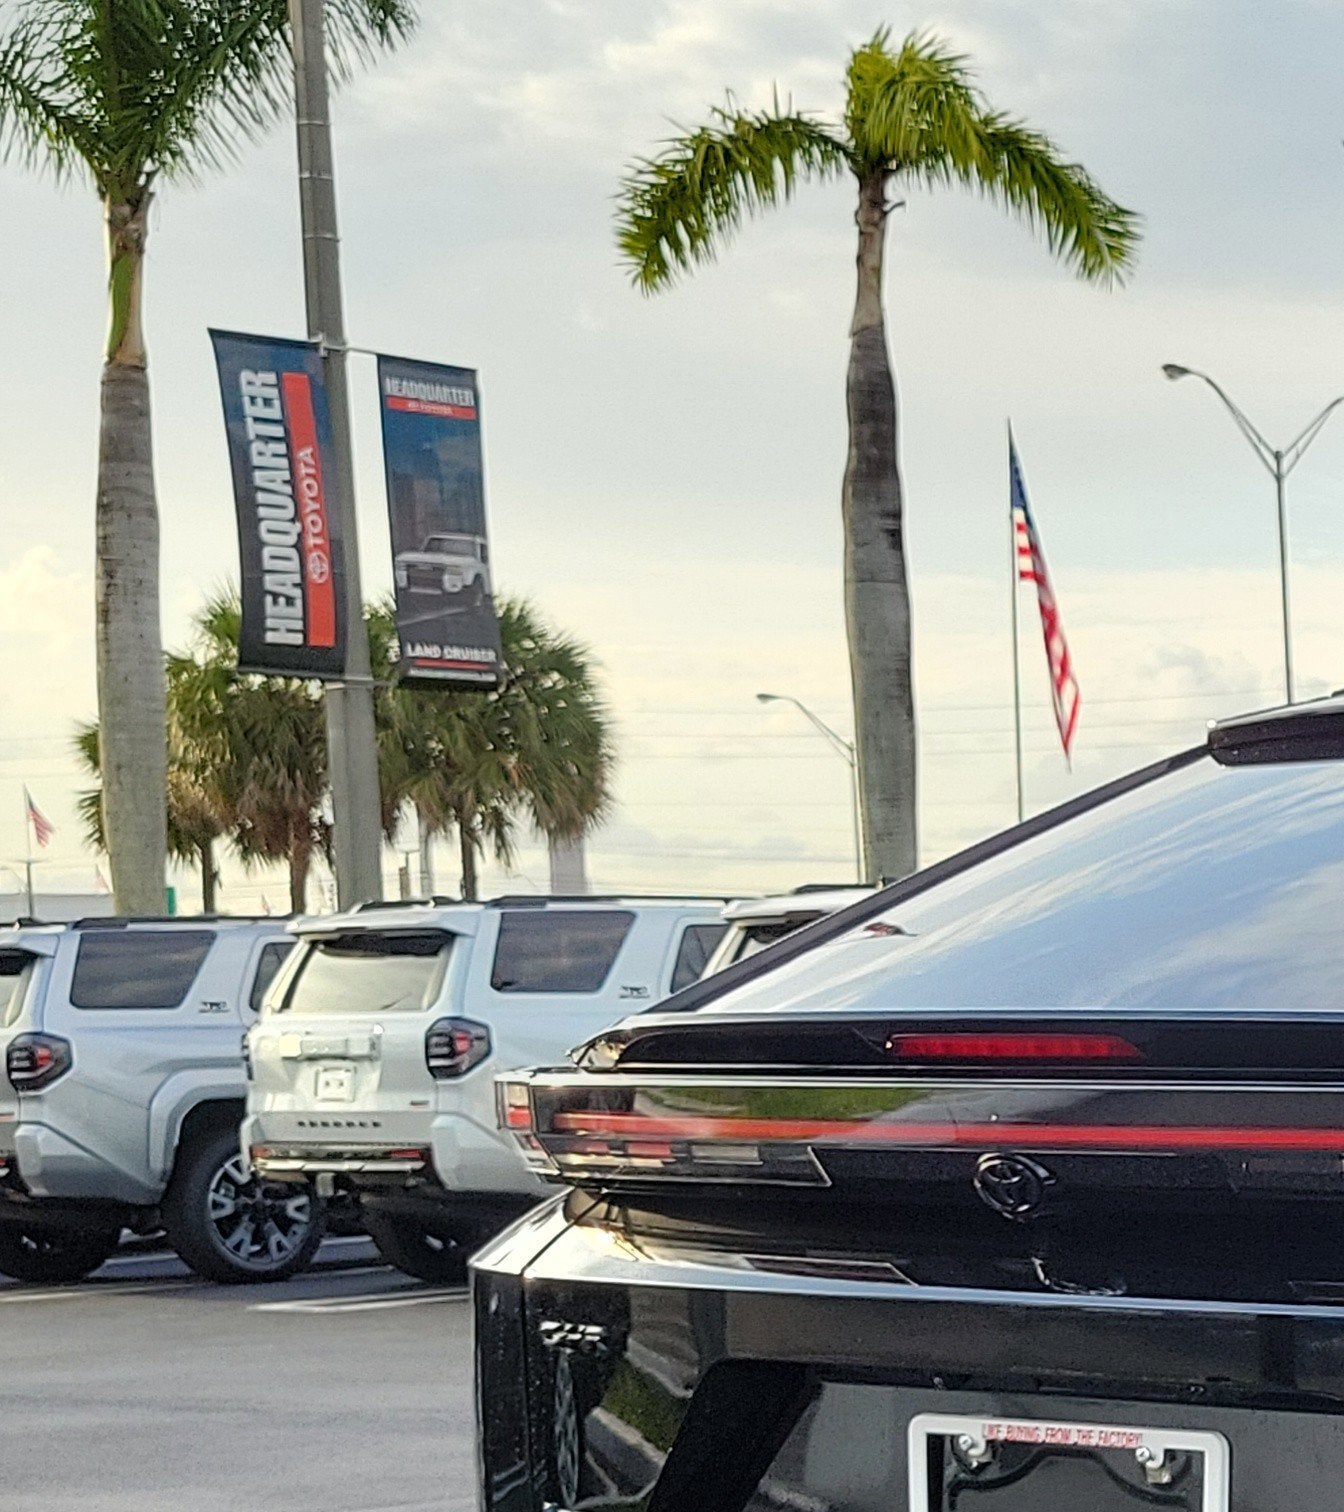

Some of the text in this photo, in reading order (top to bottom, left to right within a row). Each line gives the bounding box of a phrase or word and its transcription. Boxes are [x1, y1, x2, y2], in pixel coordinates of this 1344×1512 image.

[240, 369, 305, 646] HEADQUARTER
[299, 447, 325, 545] TOYOTA
[405, 641, 442, 658] LAND
